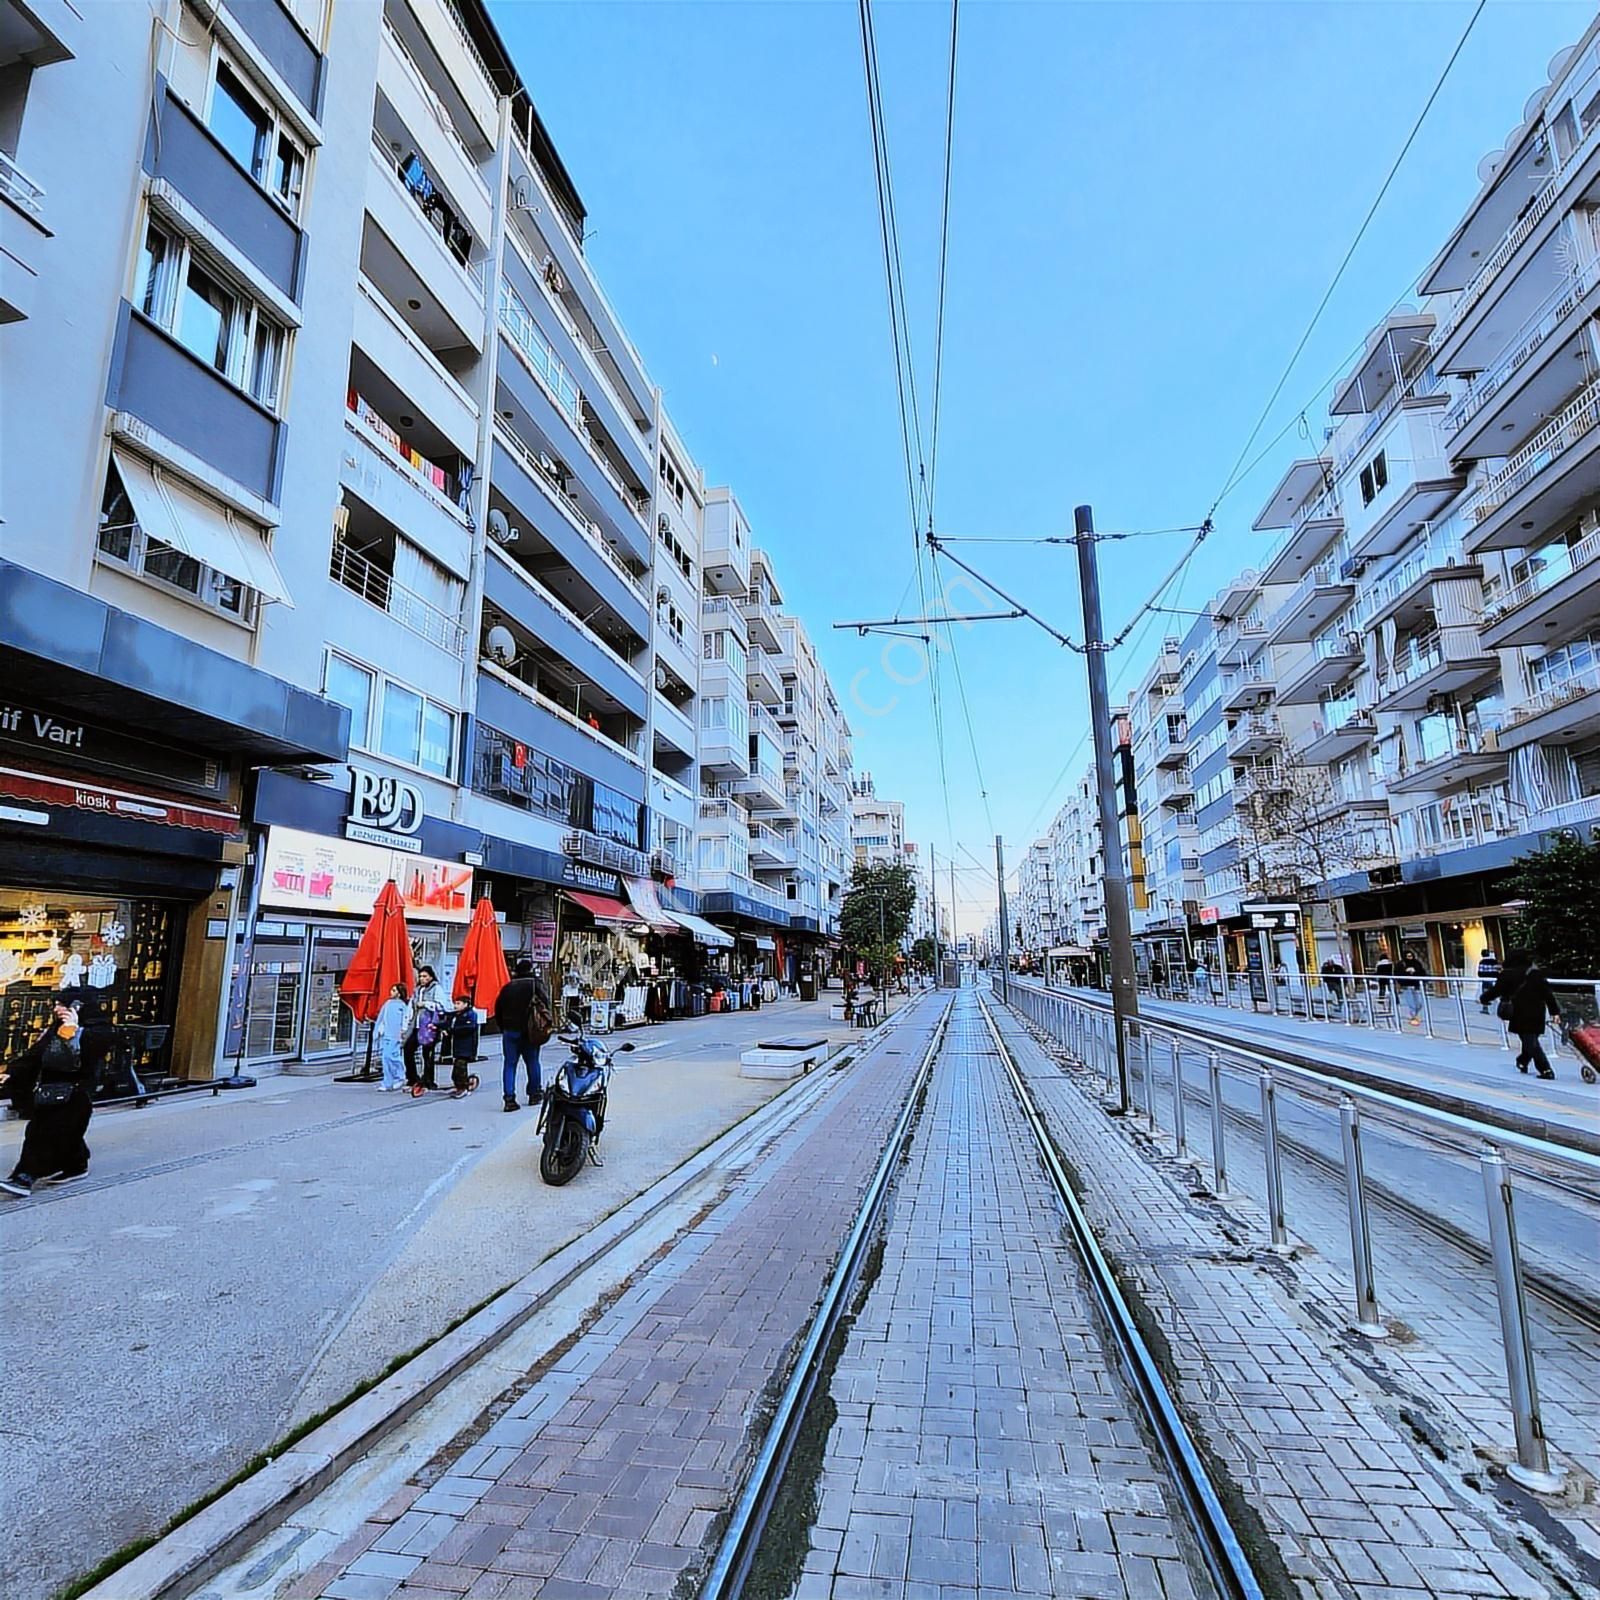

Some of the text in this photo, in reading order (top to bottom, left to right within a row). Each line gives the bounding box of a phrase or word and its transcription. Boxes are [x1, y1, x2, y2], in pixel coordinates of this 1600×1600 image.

[0, 707, 84, 747] if Var!
[75, 789, 112, 810] kiosk
